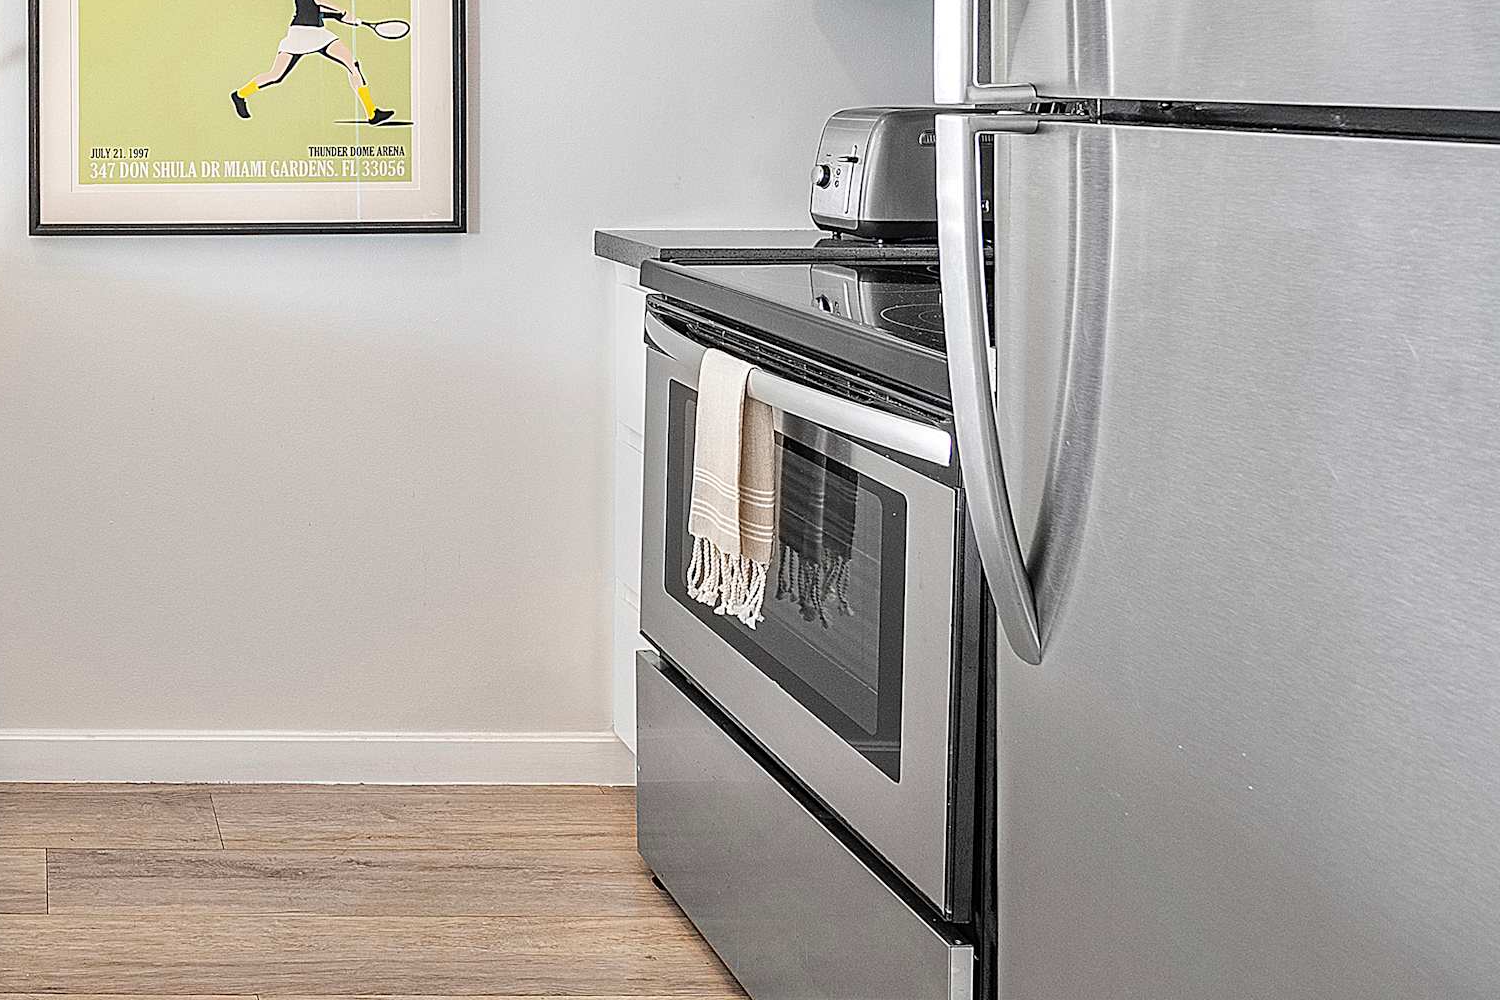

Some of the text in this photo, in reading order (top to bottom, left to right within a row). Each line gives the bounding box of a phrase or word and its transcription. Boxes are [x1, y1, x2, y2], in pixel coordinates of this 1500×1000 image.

[90, 148, 111, 159] JULY
[128, 147, 149, 159] 1997
[308, 146, 405, 157] THUNDER DOME ARENA
[90, 162, 116, 179] 347
[119, 161, 149, 179] DON
[152, 161, 197, 178] SHULA
[201, 161, 221, 178] DR
[224, 160, 267, 178] MIAMI
[341, 160, 358, 177] FL
[362, 160, 405, 177] 33056
